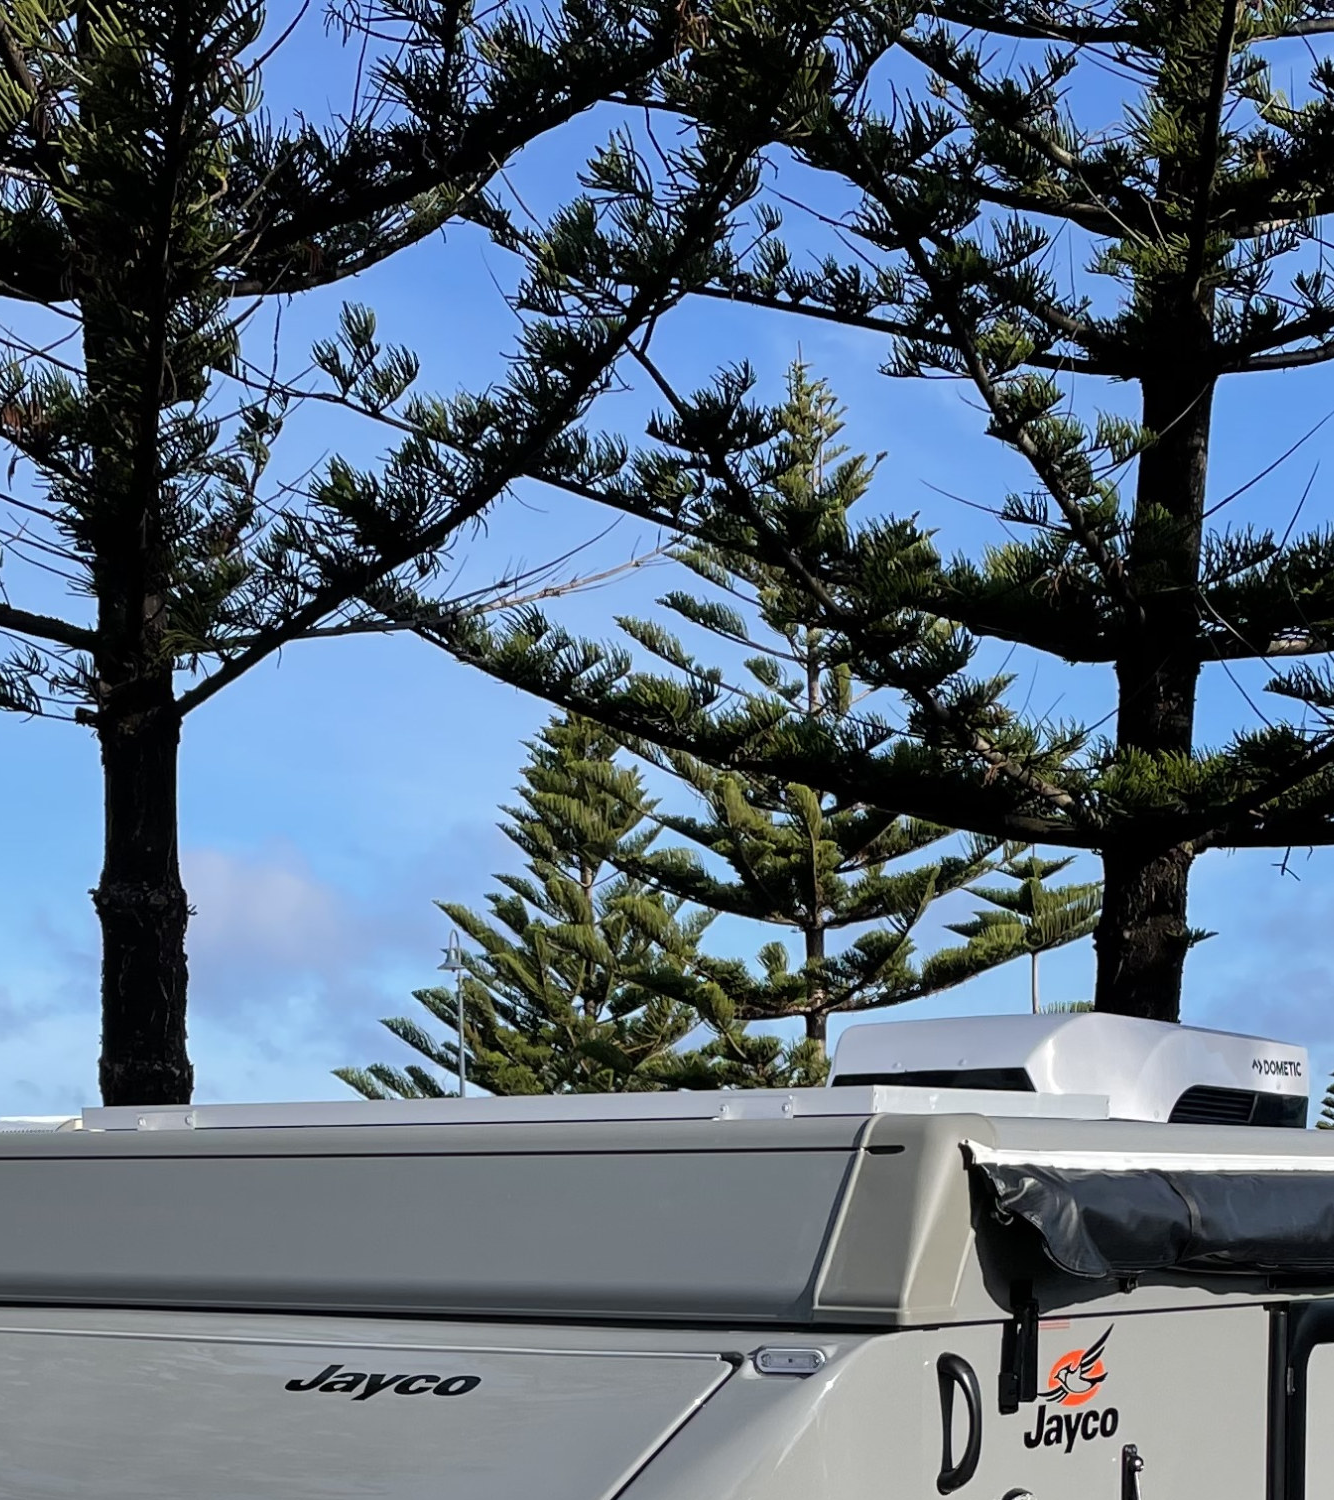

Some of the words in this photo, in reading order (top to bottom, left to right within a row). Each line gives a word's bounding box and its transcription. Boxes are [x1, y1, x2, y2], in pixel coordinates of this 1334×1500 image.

[1263, 1059, 1302, 1077] DOMETIC
[284, 1364, 482, 1401] Jayco
[1023, 1404, 1119, 1454] Jayco
